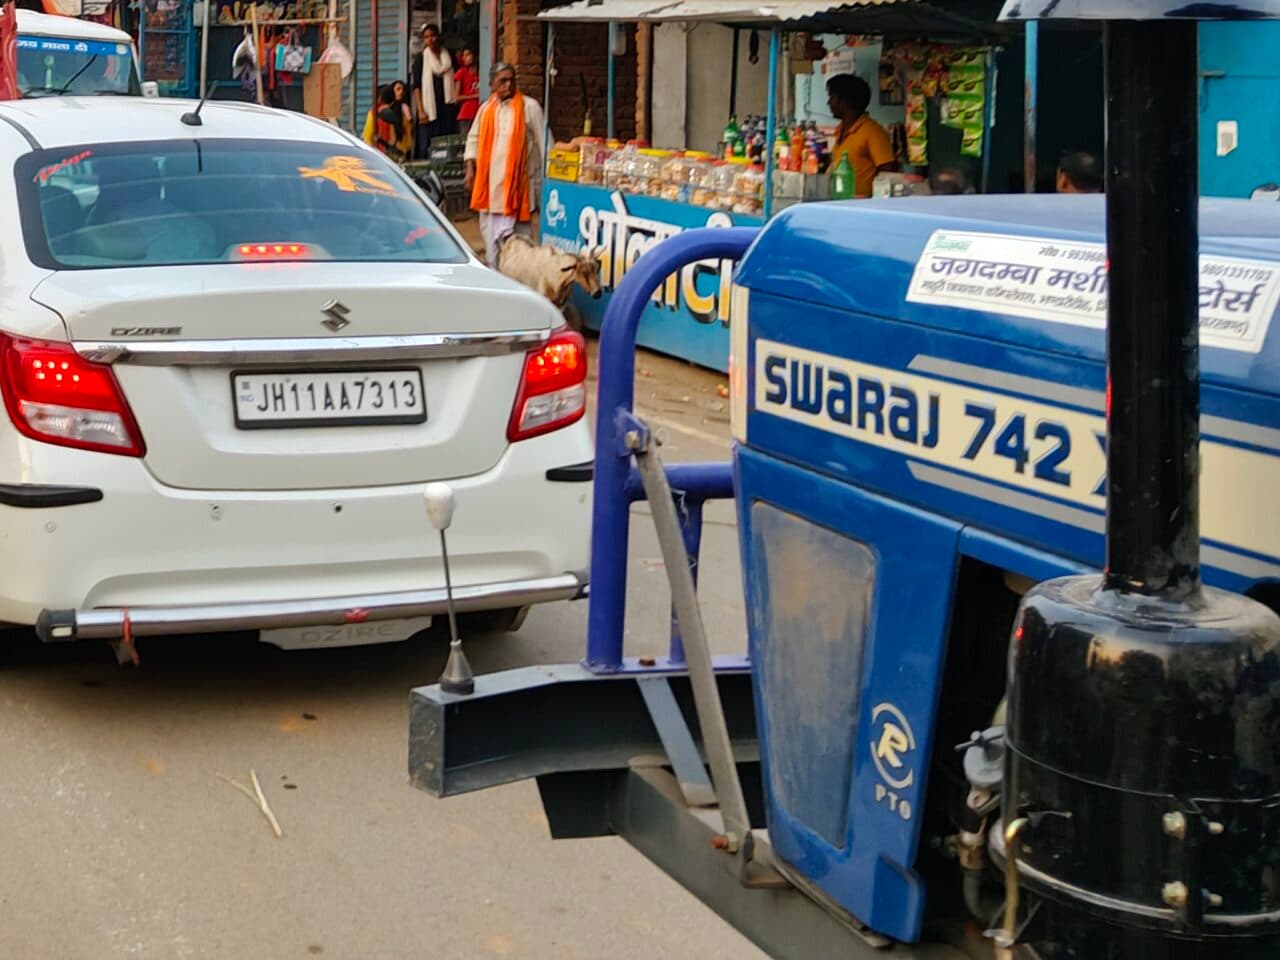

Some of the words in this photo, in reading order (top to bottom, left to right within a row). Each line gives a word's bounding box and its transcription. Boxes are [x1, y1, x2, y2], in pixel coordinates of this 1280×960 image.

[256, 378, 417, 413] JH11AA7313
[960, 401, 1072, 487] 742
[875, 783, 912, 821] PTO
